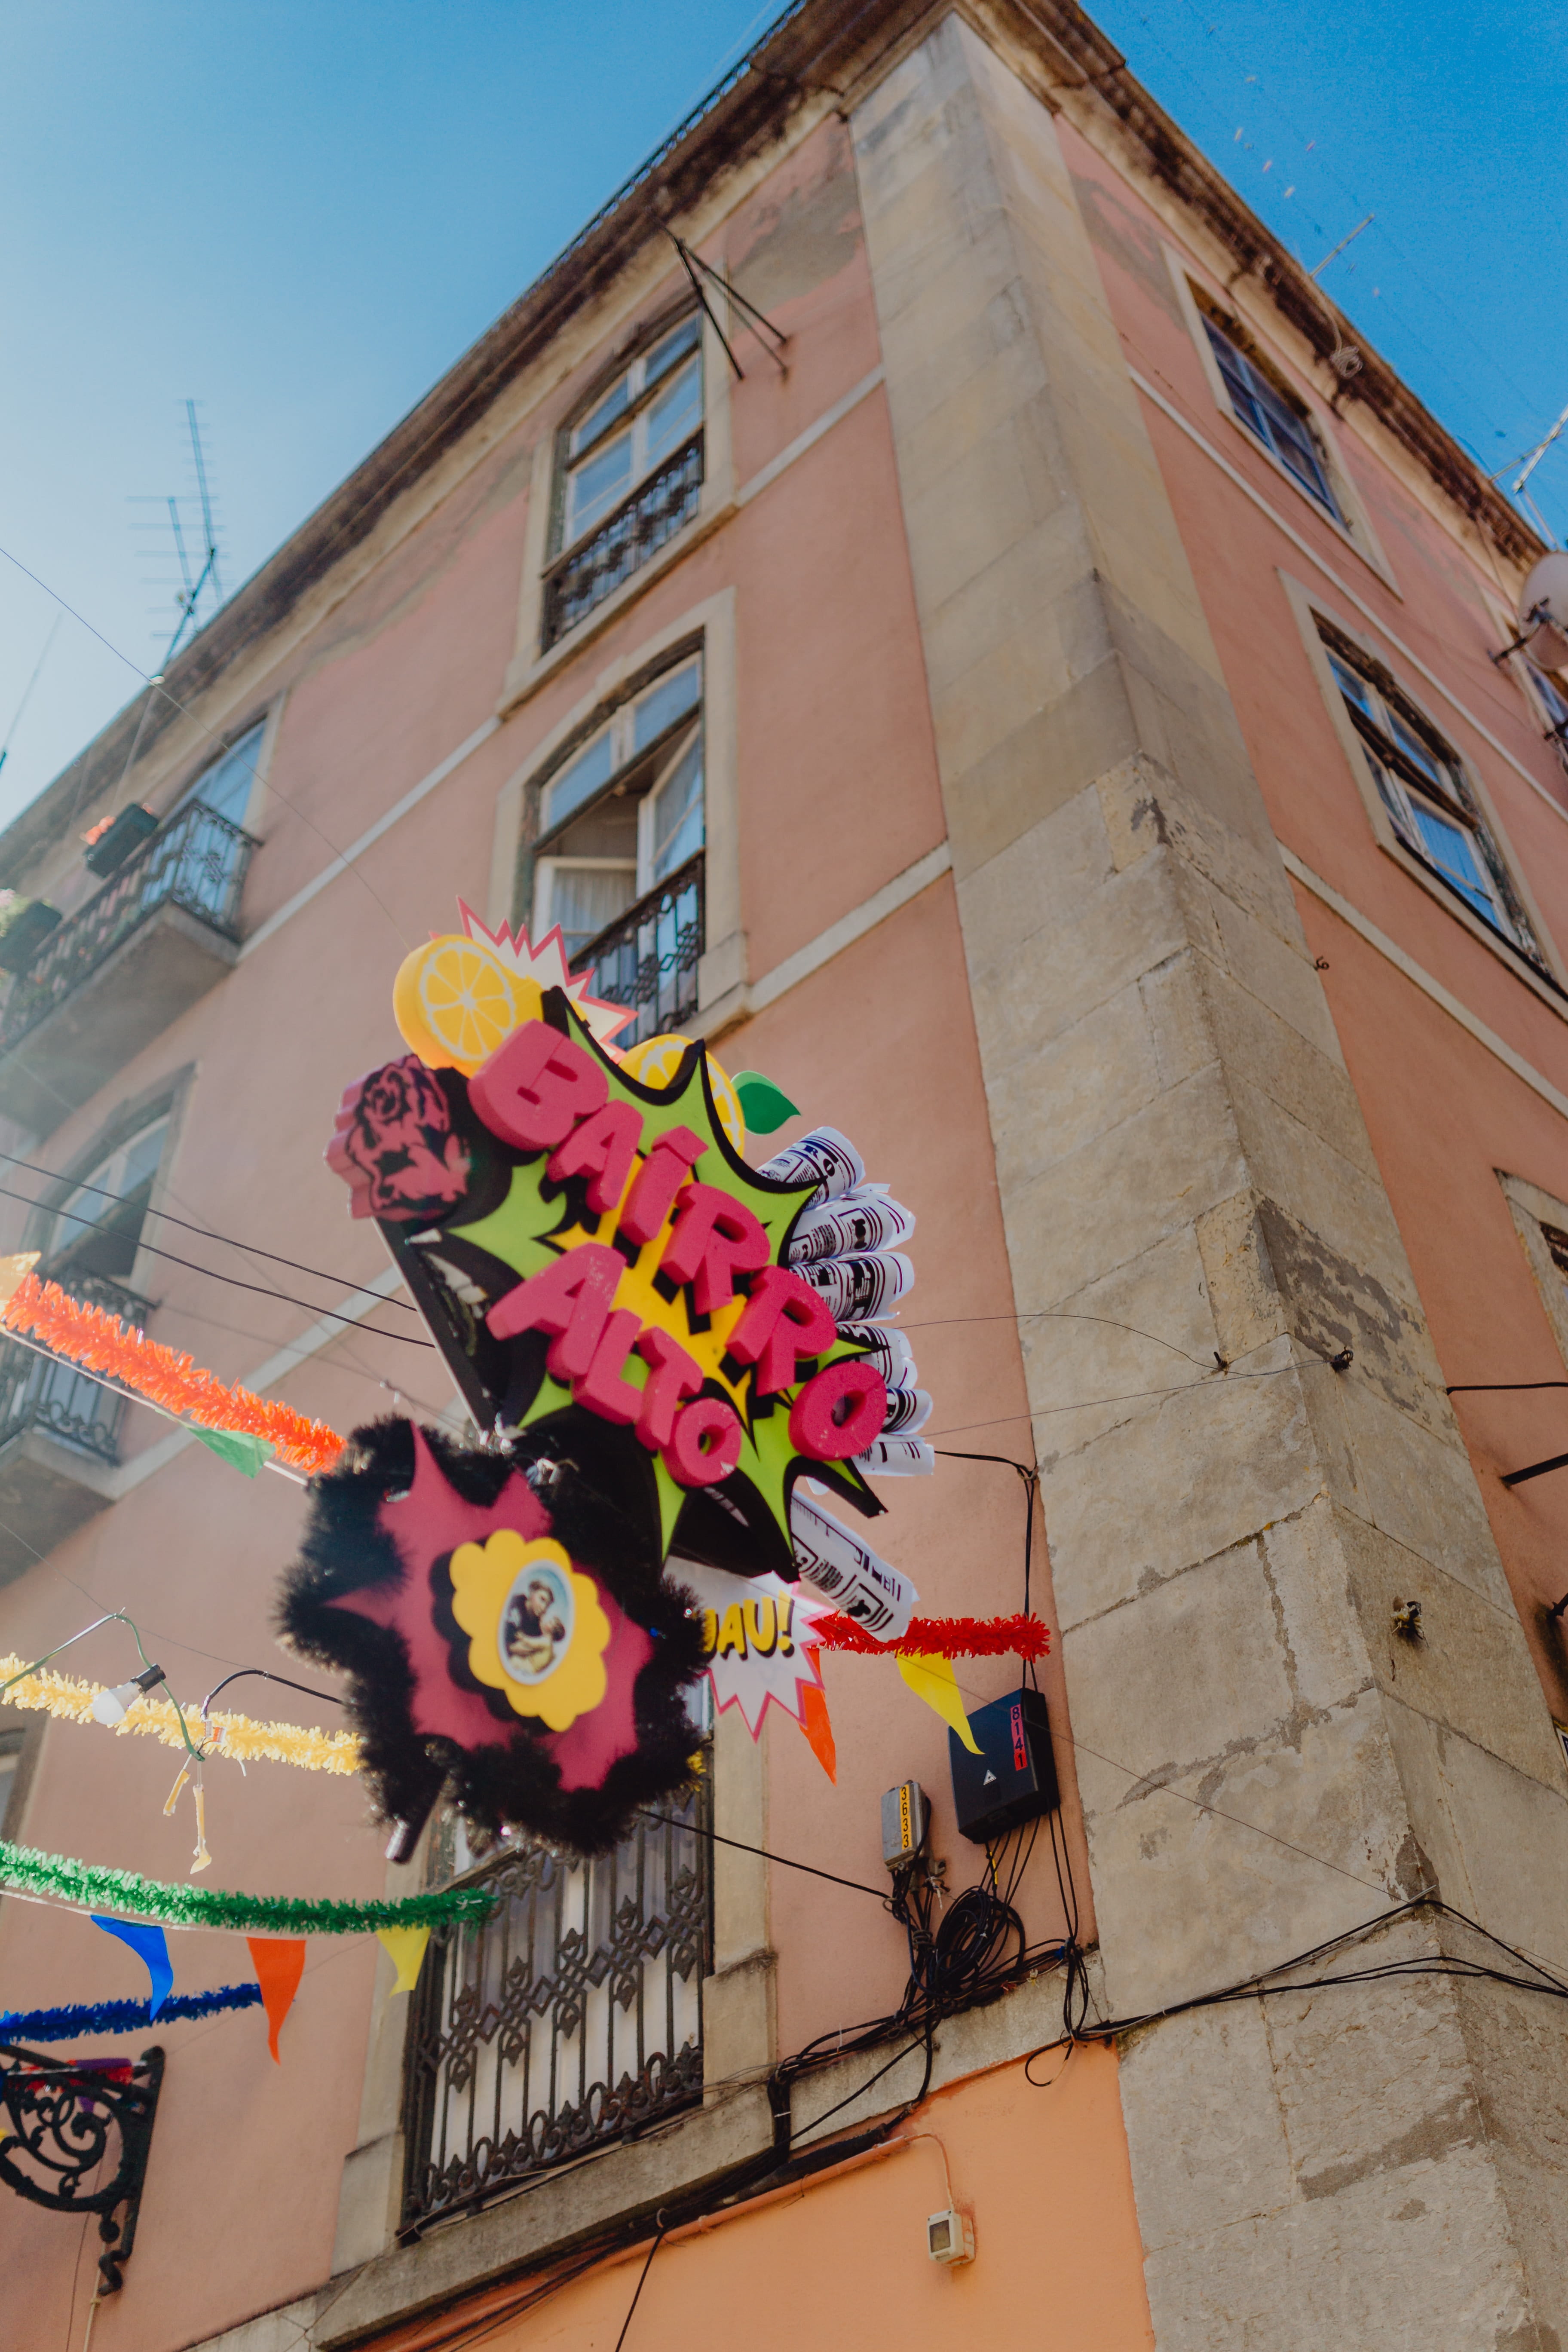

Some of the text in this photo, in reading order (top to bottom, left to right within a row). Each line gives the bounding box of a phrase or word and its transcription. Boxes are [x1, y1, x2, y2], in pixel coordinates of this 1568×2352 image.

[485, 1242, 741, 1488] ALTO
[1011, 1706, 1025, 1768] 8141
[900, 1786, 911, 1849] 3633
